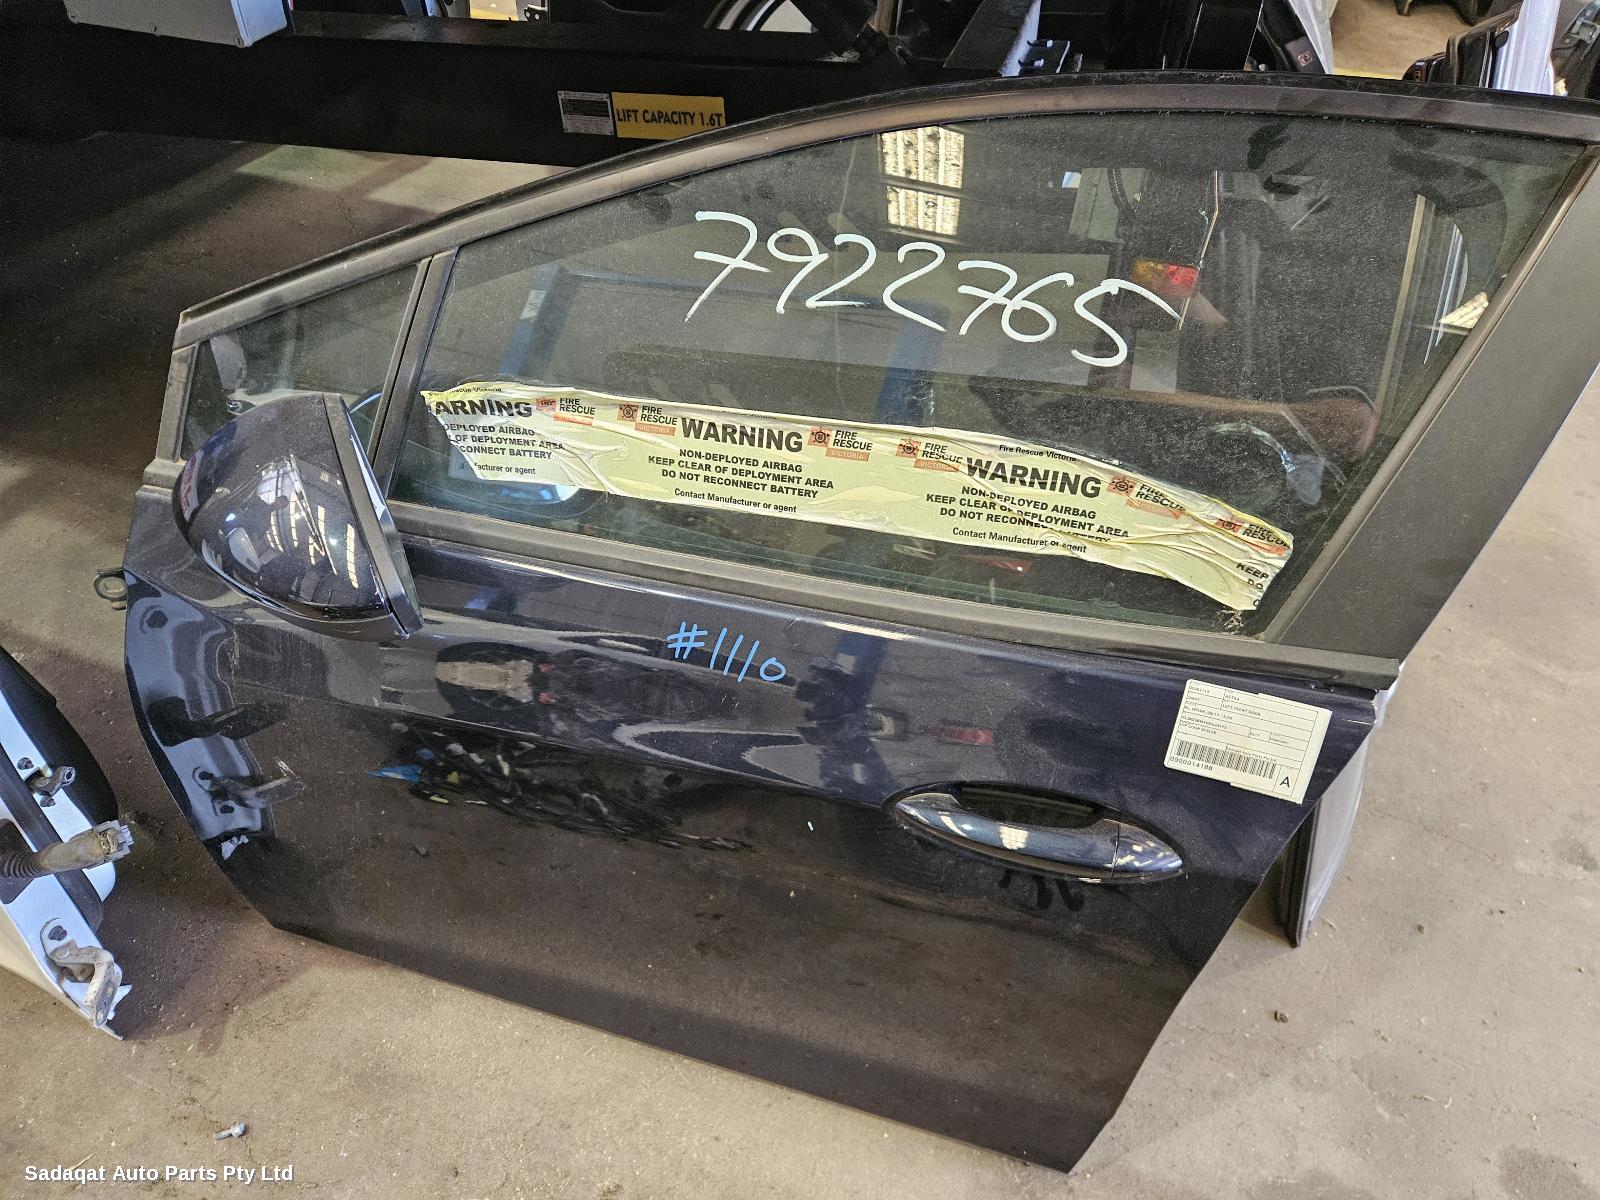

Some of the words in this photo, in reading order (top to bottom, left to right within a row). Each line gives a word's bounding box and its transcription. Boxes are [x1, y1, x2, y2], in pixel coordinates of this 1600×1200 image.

[616, 109, 640, 123] LIFT
[642, 110, 696, 126] CAPACITY
[699, 112, 723, 127] 1.6T
[684, 211, 1183, 368] 7922765
[430, 399, 533, 418] ARNING
[559, 403, 596, 416] RESCUE
[560, 397, 581, 406] FIRE
[641, 405, 663, 416] FIRE
[640, 414, 678, 426] RESCUE
[455, 434, 468, 443] OF
[471, 436, 536, 447] DEPLOYMENT
[538, 440, 565, 451] AREA
[681, 417, 803, 453] WARNING
[835, 430, 858, 440] FIRE
[509, 448, 553, 460] BATTERY
[832, 439, 873, 452] RESCUE
[924, 442, 948, 454] FIRE
[999, 444, 1015, 453] Fire
[1015, 446, 1044, 457] Rescue
[1046, 450, 1077, 462] Victoria
[679, 449, 759, 467] NON-DEPLOYED
[762, 460, 803, 473] AIRBAG
[830, 450, 865, 460] VICTORIA
[921, 449, 964, 464] RESCUE
[514, 467, 536, 476] agent
[648, 455, 676, 466] KEEP
[677, 459, 712, 472] CLEAR
[714, 465, 729, 475] OF
[731, 467, 802, 485] DEPLOYMENT
[804, 478, 834, 489] AREA
[966, 456, 1102, 499] WARNING
[661, 468, 677, 478] DO
[679, 472, 701, 482] NOT
[703, 475, 768, 492] RECONNECT
[770, 484, 819, 499] BATTERY
[674, 487, 705, 500] Contact
[707, 493, 761, 509] Manufacturer
[762, 502, 772, 510] or
[773, 503, 797, 514] agent
[961, 485, 1049, 511] NON-DEPLOYED
[1051, 505, 1097, 520] AIRBAG
[926, 493, 956, 505] KEEP
[959, 497, 997, 511] CLEAR
[1016, 509, 1095, 532] DEPLOYMENT
[1096, 525, 1129, 538] AREA
[940, 507, 956, 517] DO
[959, 510, 983, 521] NOT
[986, 513, 1050, 529] RECONNE
[952, 527, 986, 540] Contact
[988, 531, 1048, 547] Manufacturer
[1050, 539, 1060, 547] or
[1236, 562, 1269, 579] KEEP
[1247, 578, 1264, 590] DO
[666, 621, 787, 682] #1110
[1279, 776, 1290, 788] A
